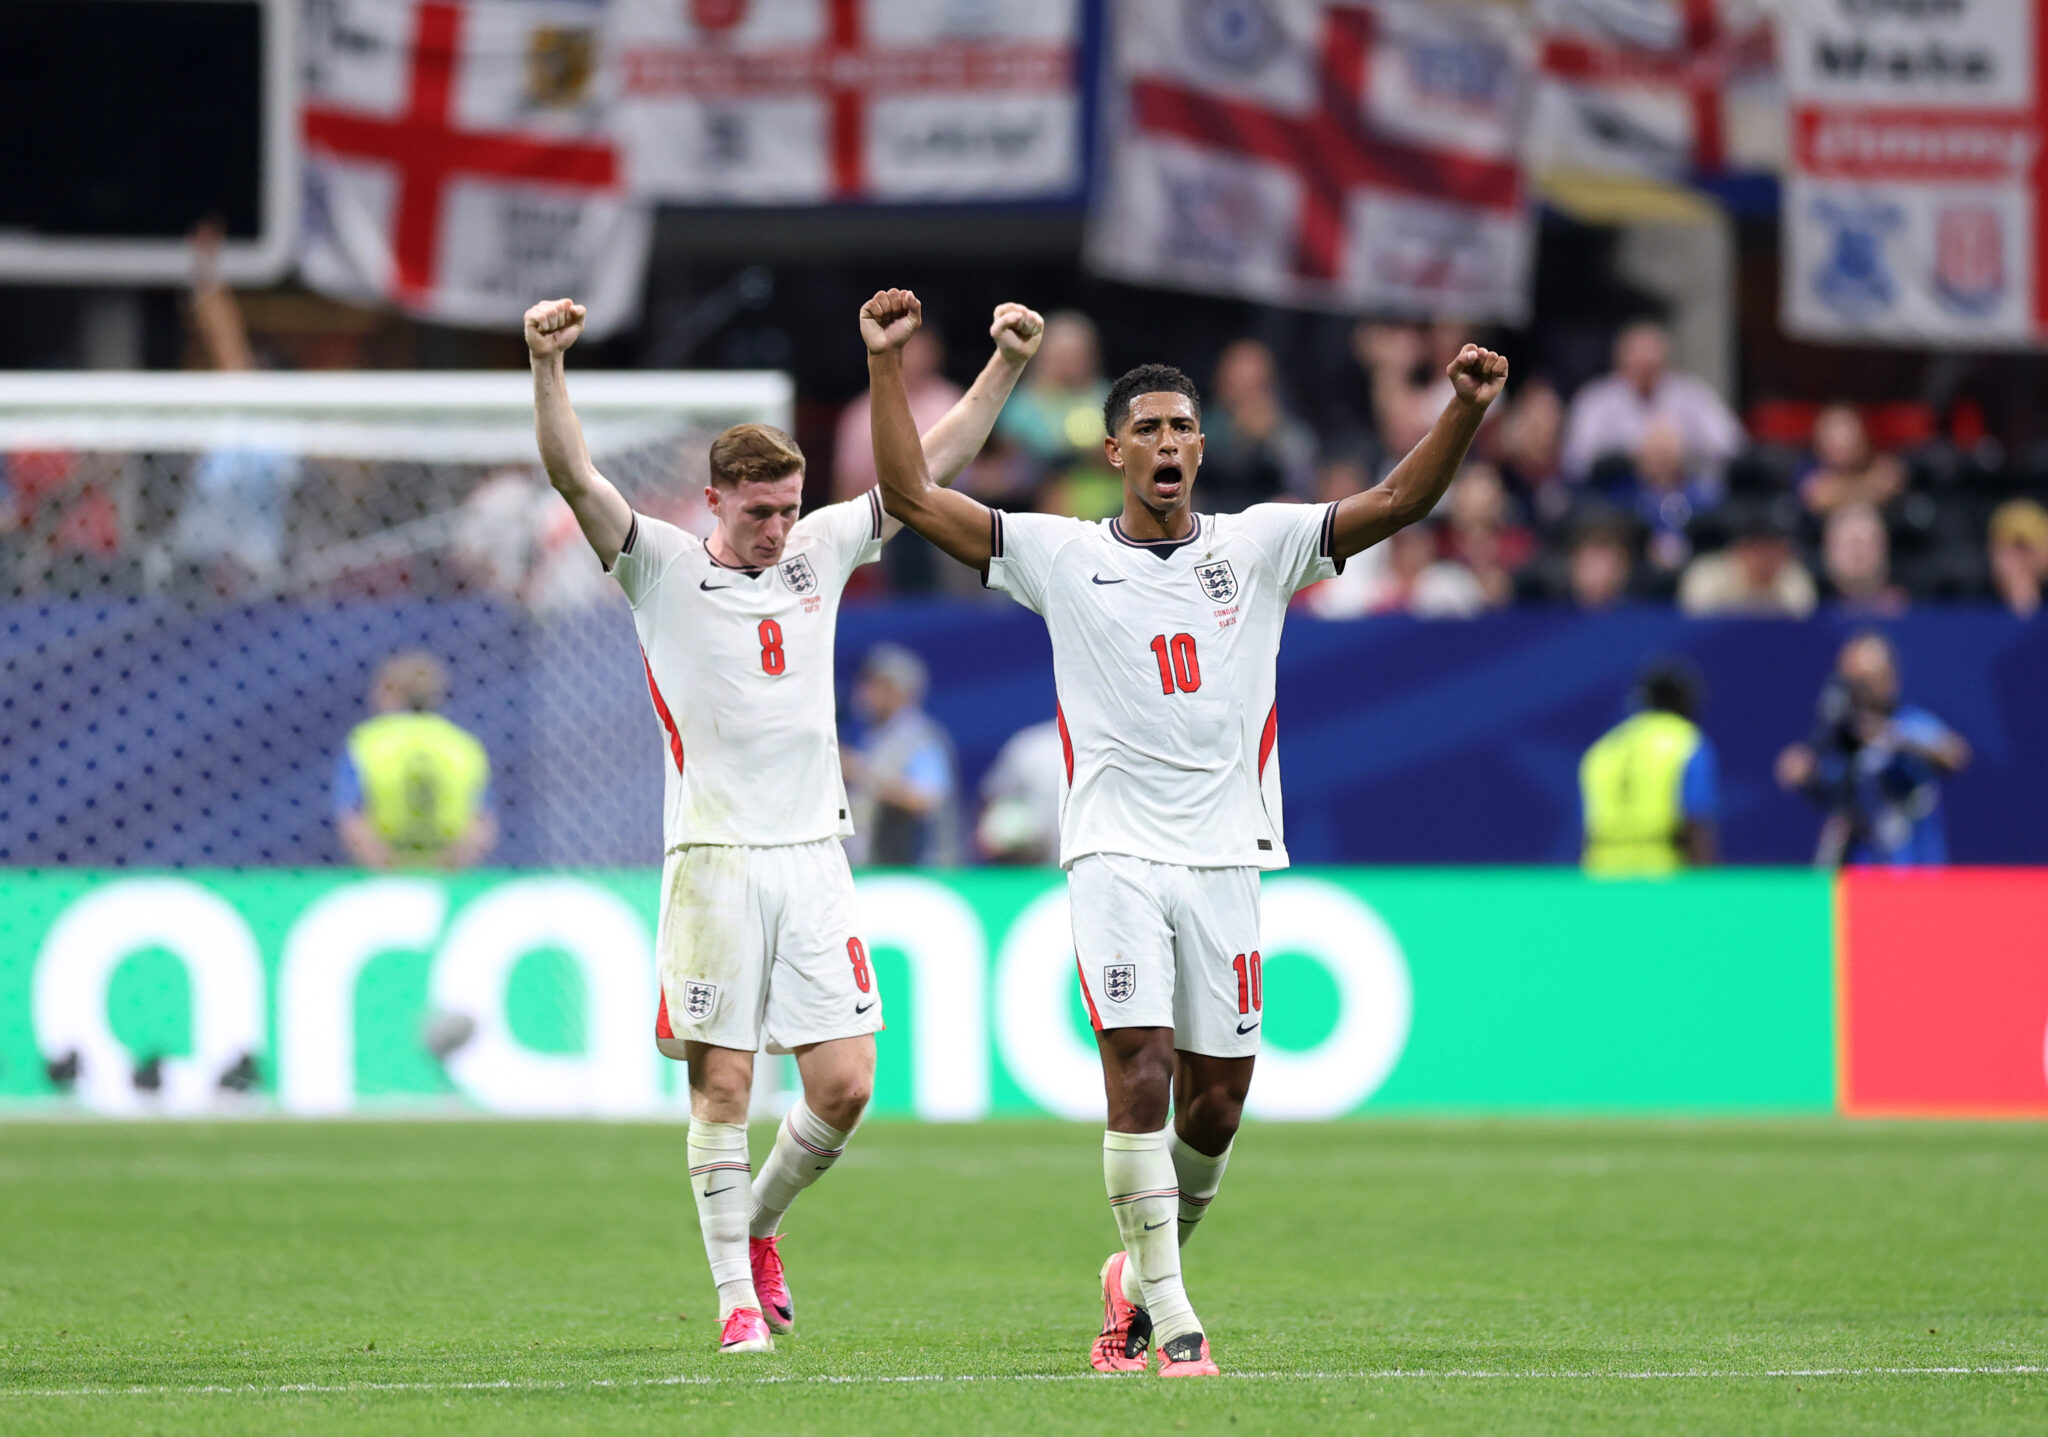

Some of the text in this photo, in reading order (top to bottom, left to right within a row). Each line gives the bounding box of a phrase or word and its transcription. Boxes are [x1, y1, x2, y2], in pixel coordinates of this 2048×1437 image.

[758, 618, 786, 676] 8
[1150, 632, 1202, 696] 10
[846, 936, 871, 994] 8
[1232, 950, 1262, 1015] 10
